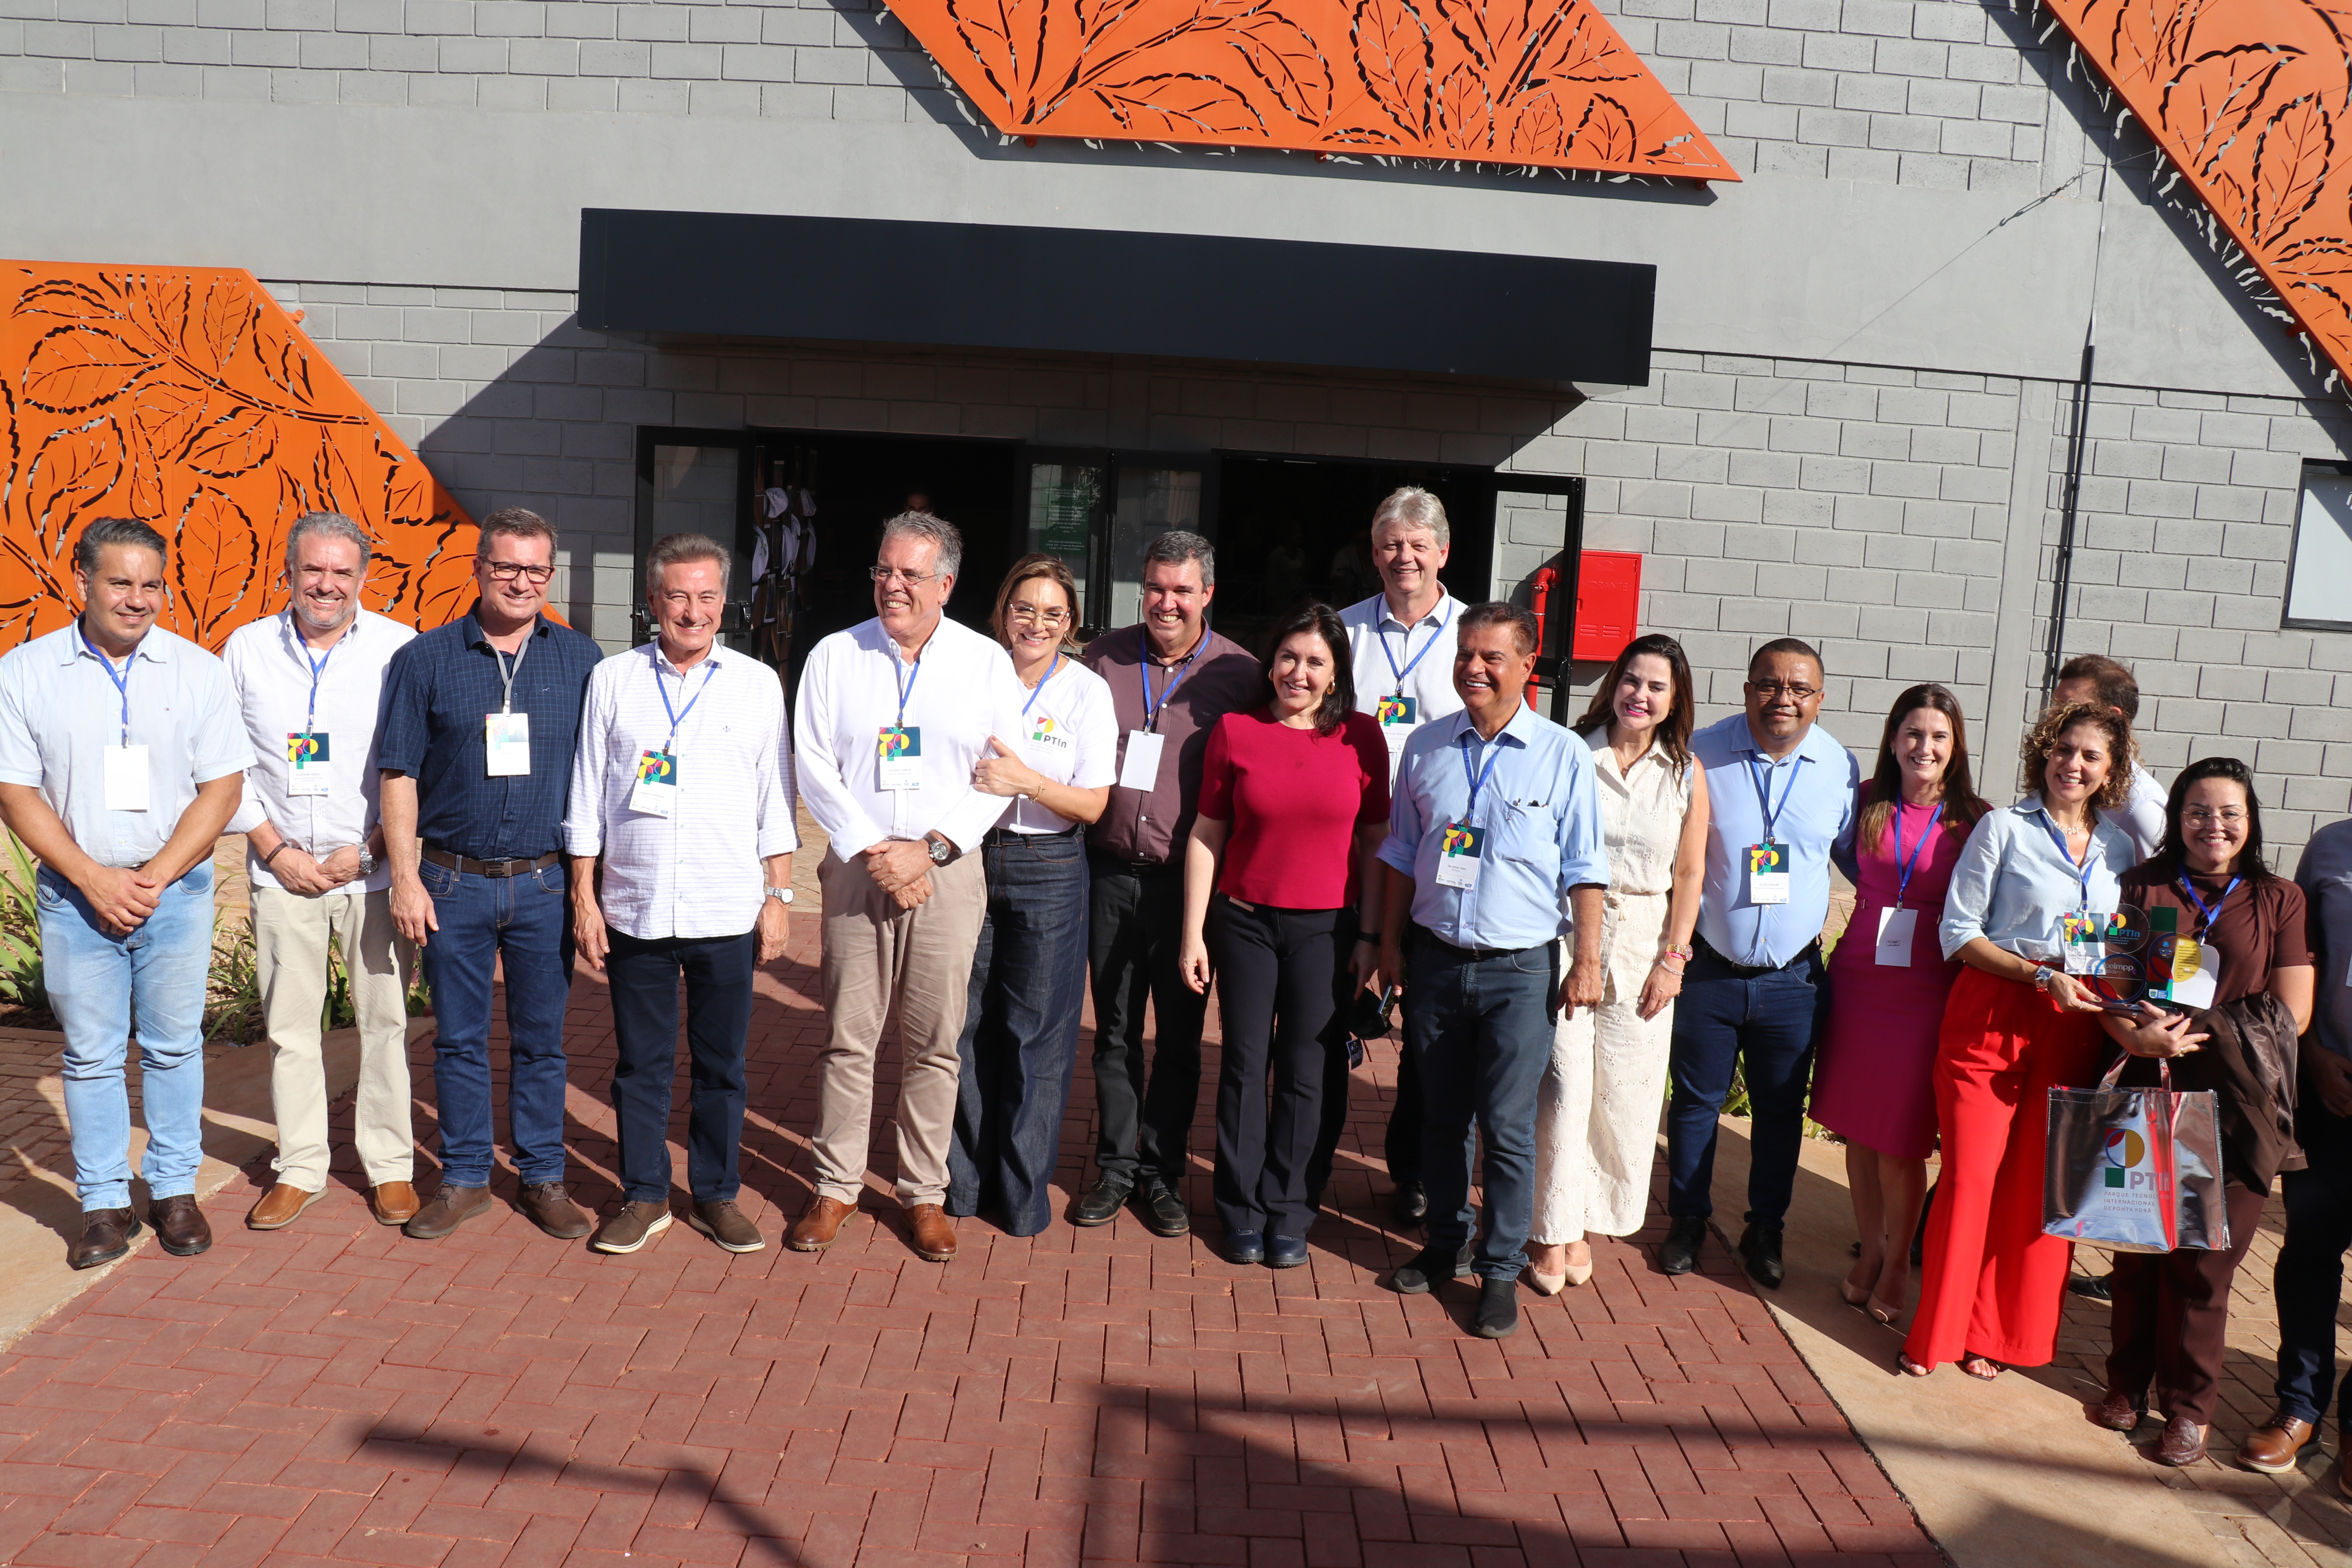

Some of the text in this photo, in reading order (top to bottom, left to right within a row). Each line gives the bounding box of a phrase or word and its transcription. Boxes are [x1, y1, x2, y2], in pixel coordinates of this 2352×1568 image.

[1581, 580, 1628, 591] HIDRANTE
[1044, 735, 1067, 748] PTIn
[2119, 929, 2140, 937] PTIn
[2105, 962, 2134, 972] ceimpp
[1352, 1049, 1363, 1063] BONÉS
[2130, 1171, 2169, 1191] PTIn
